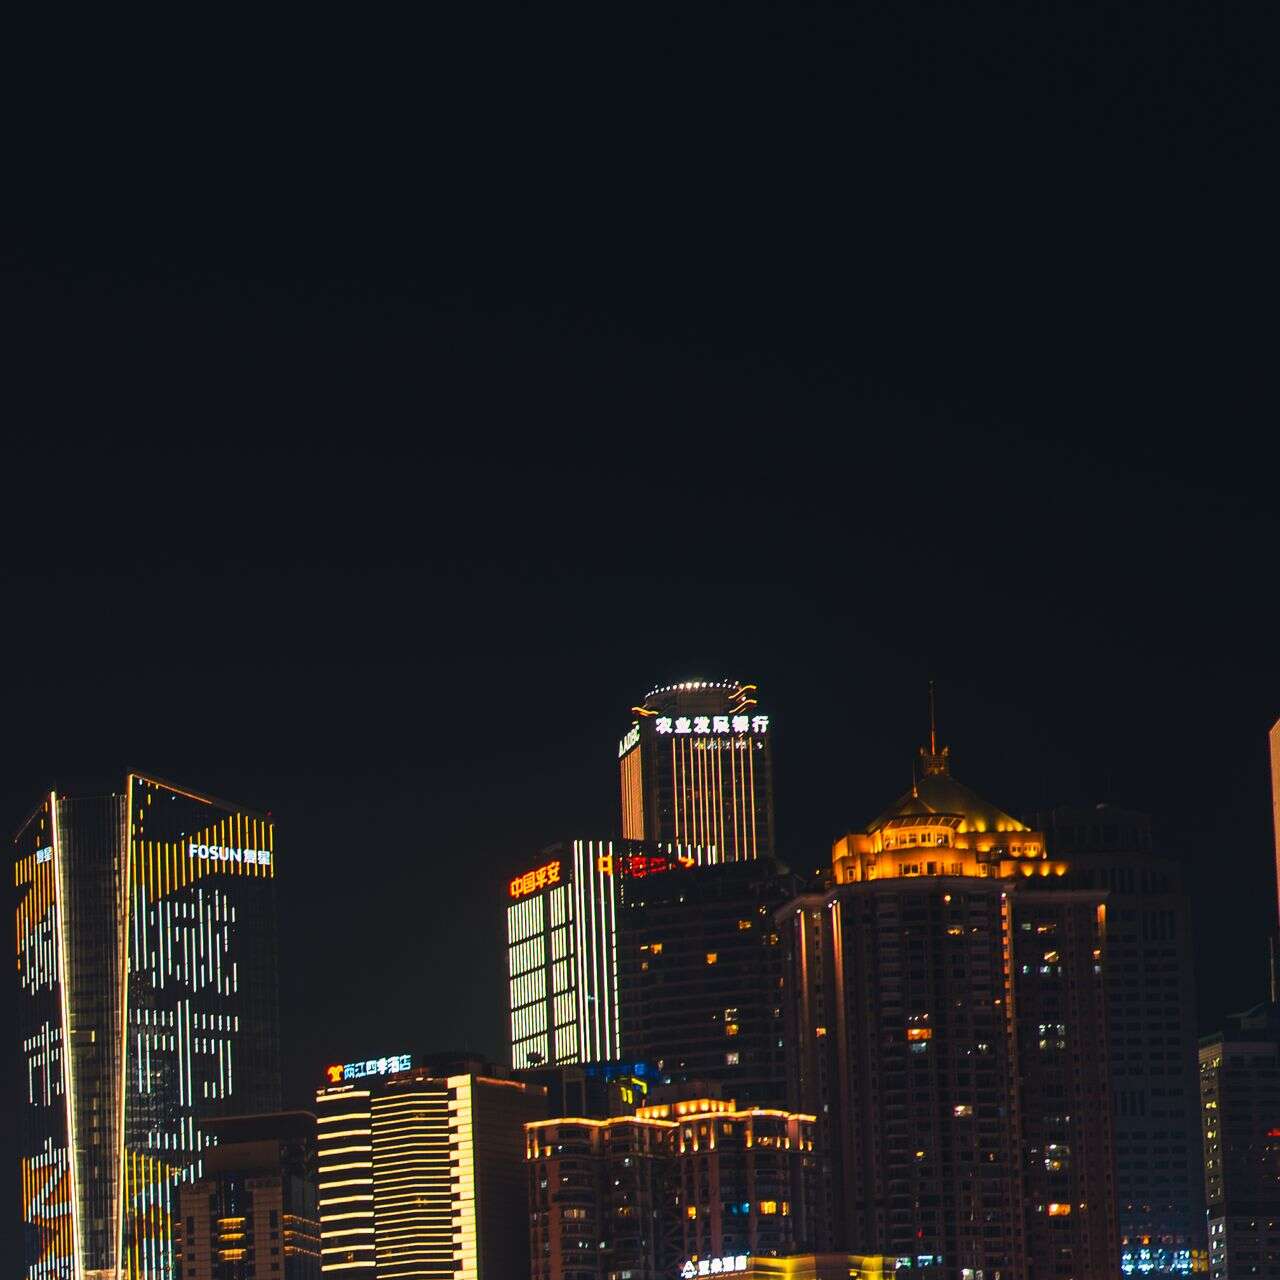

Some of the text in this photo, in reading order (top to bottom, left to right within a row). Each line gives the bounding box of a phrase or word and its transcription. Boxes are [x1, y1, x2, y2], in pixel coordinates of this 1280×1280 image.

[655, 715, 769, 734] 农业发展银行
[189, 844, 241, 862] FOSUN
[510, 861, 560, 898] 中国平安
[343, 1054, 411, 1080] 两江四季酒店
